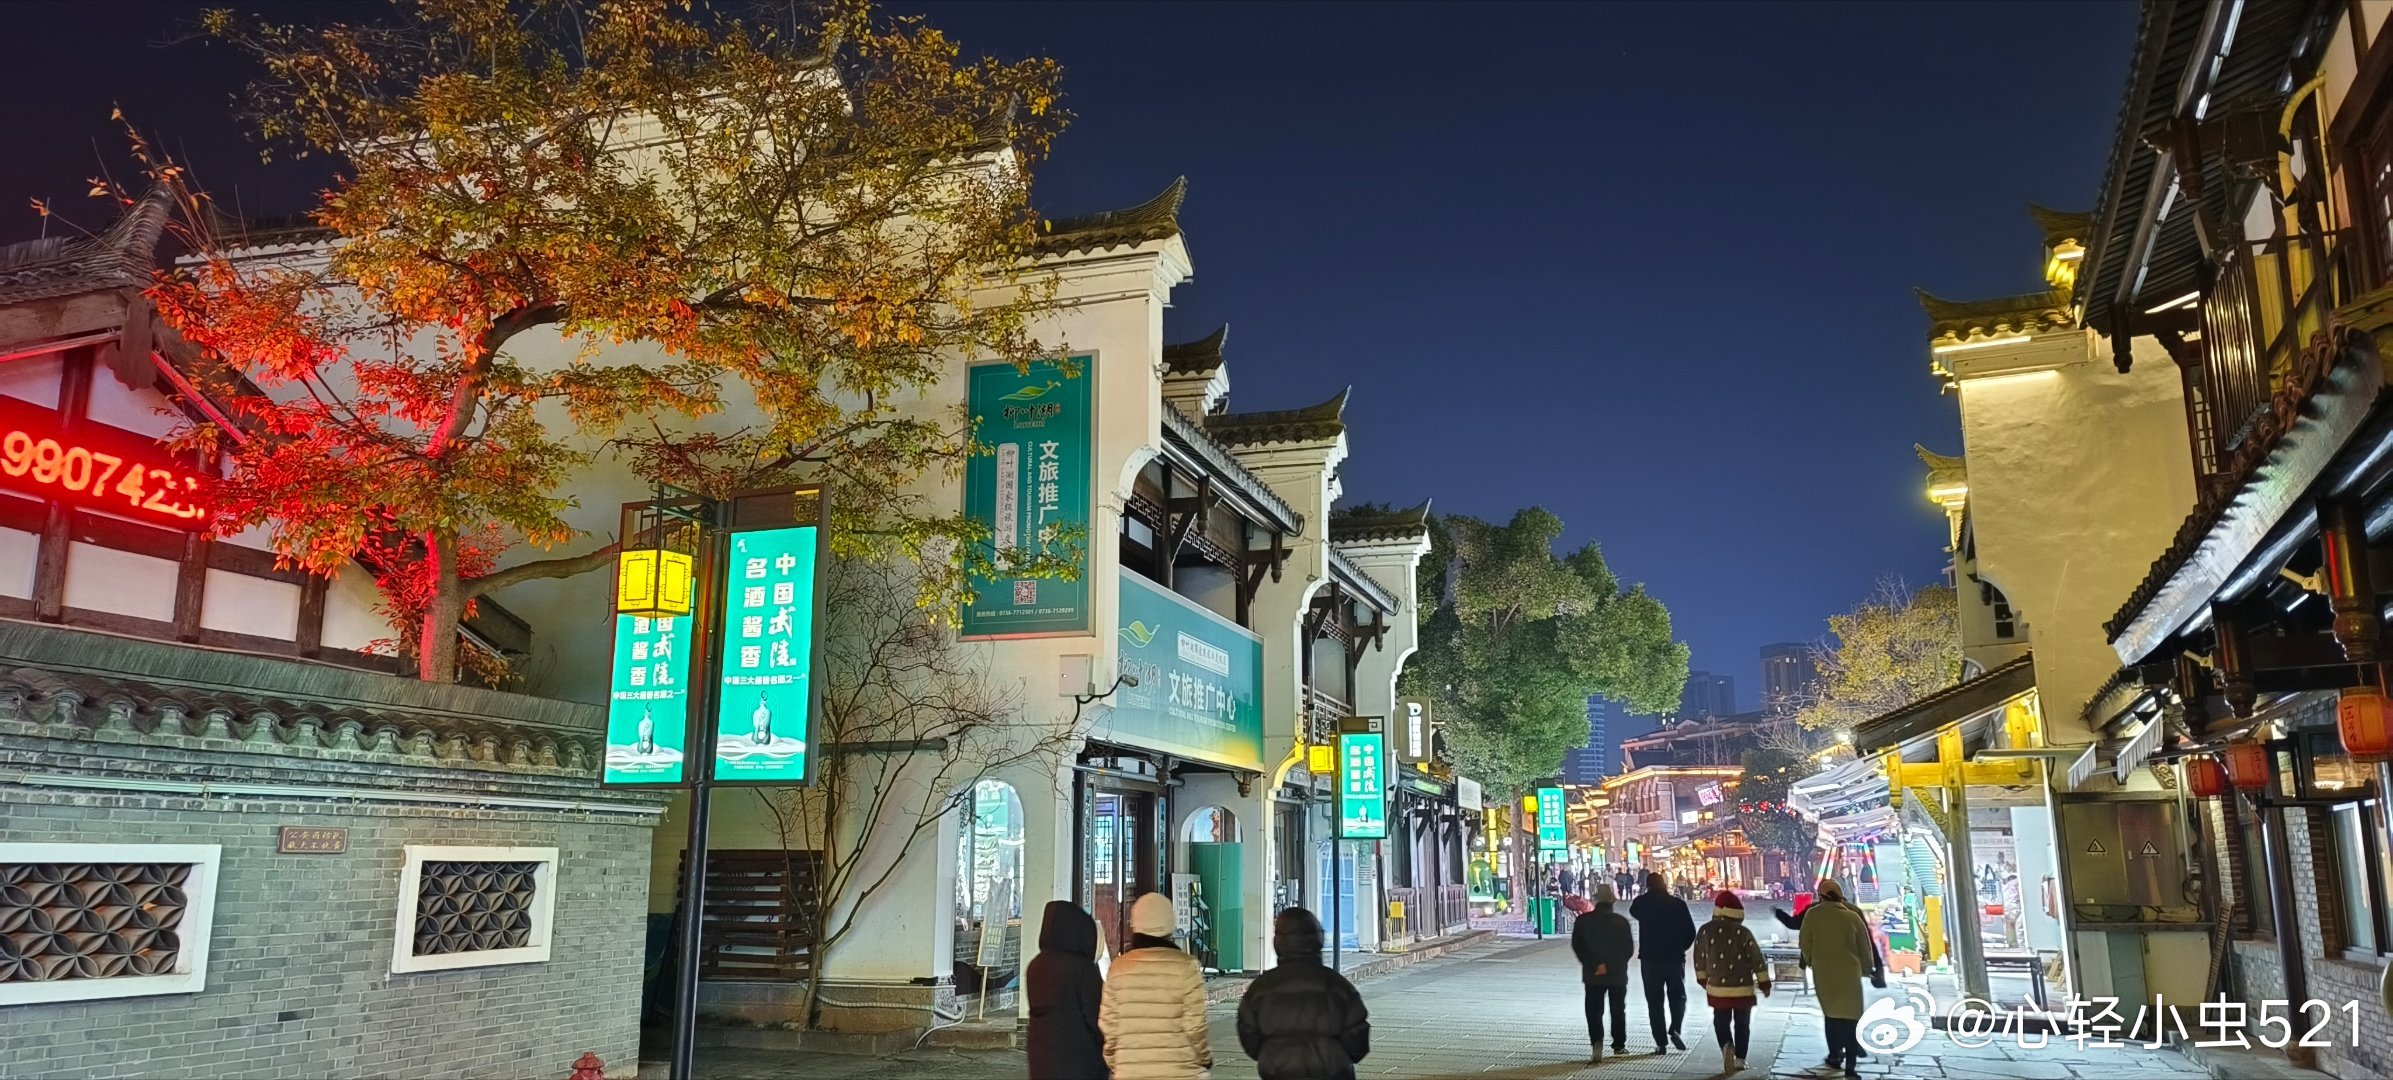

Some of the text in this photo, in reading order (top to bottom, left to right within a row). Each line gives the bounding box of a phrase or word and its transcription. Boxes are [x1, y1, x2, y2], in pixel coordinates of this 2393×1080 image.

[1038, 440, 1059, 563] 文旅推广中
[630, 617, 650, 686] 酒酱香
[652, 617, 675, 686] 国武陵
[740, 557, 768, 668] 名酒酱香
[768, 552, 797, 669] 中国武陵
[1169, 669, 1237, 721] 文旅推广中心
